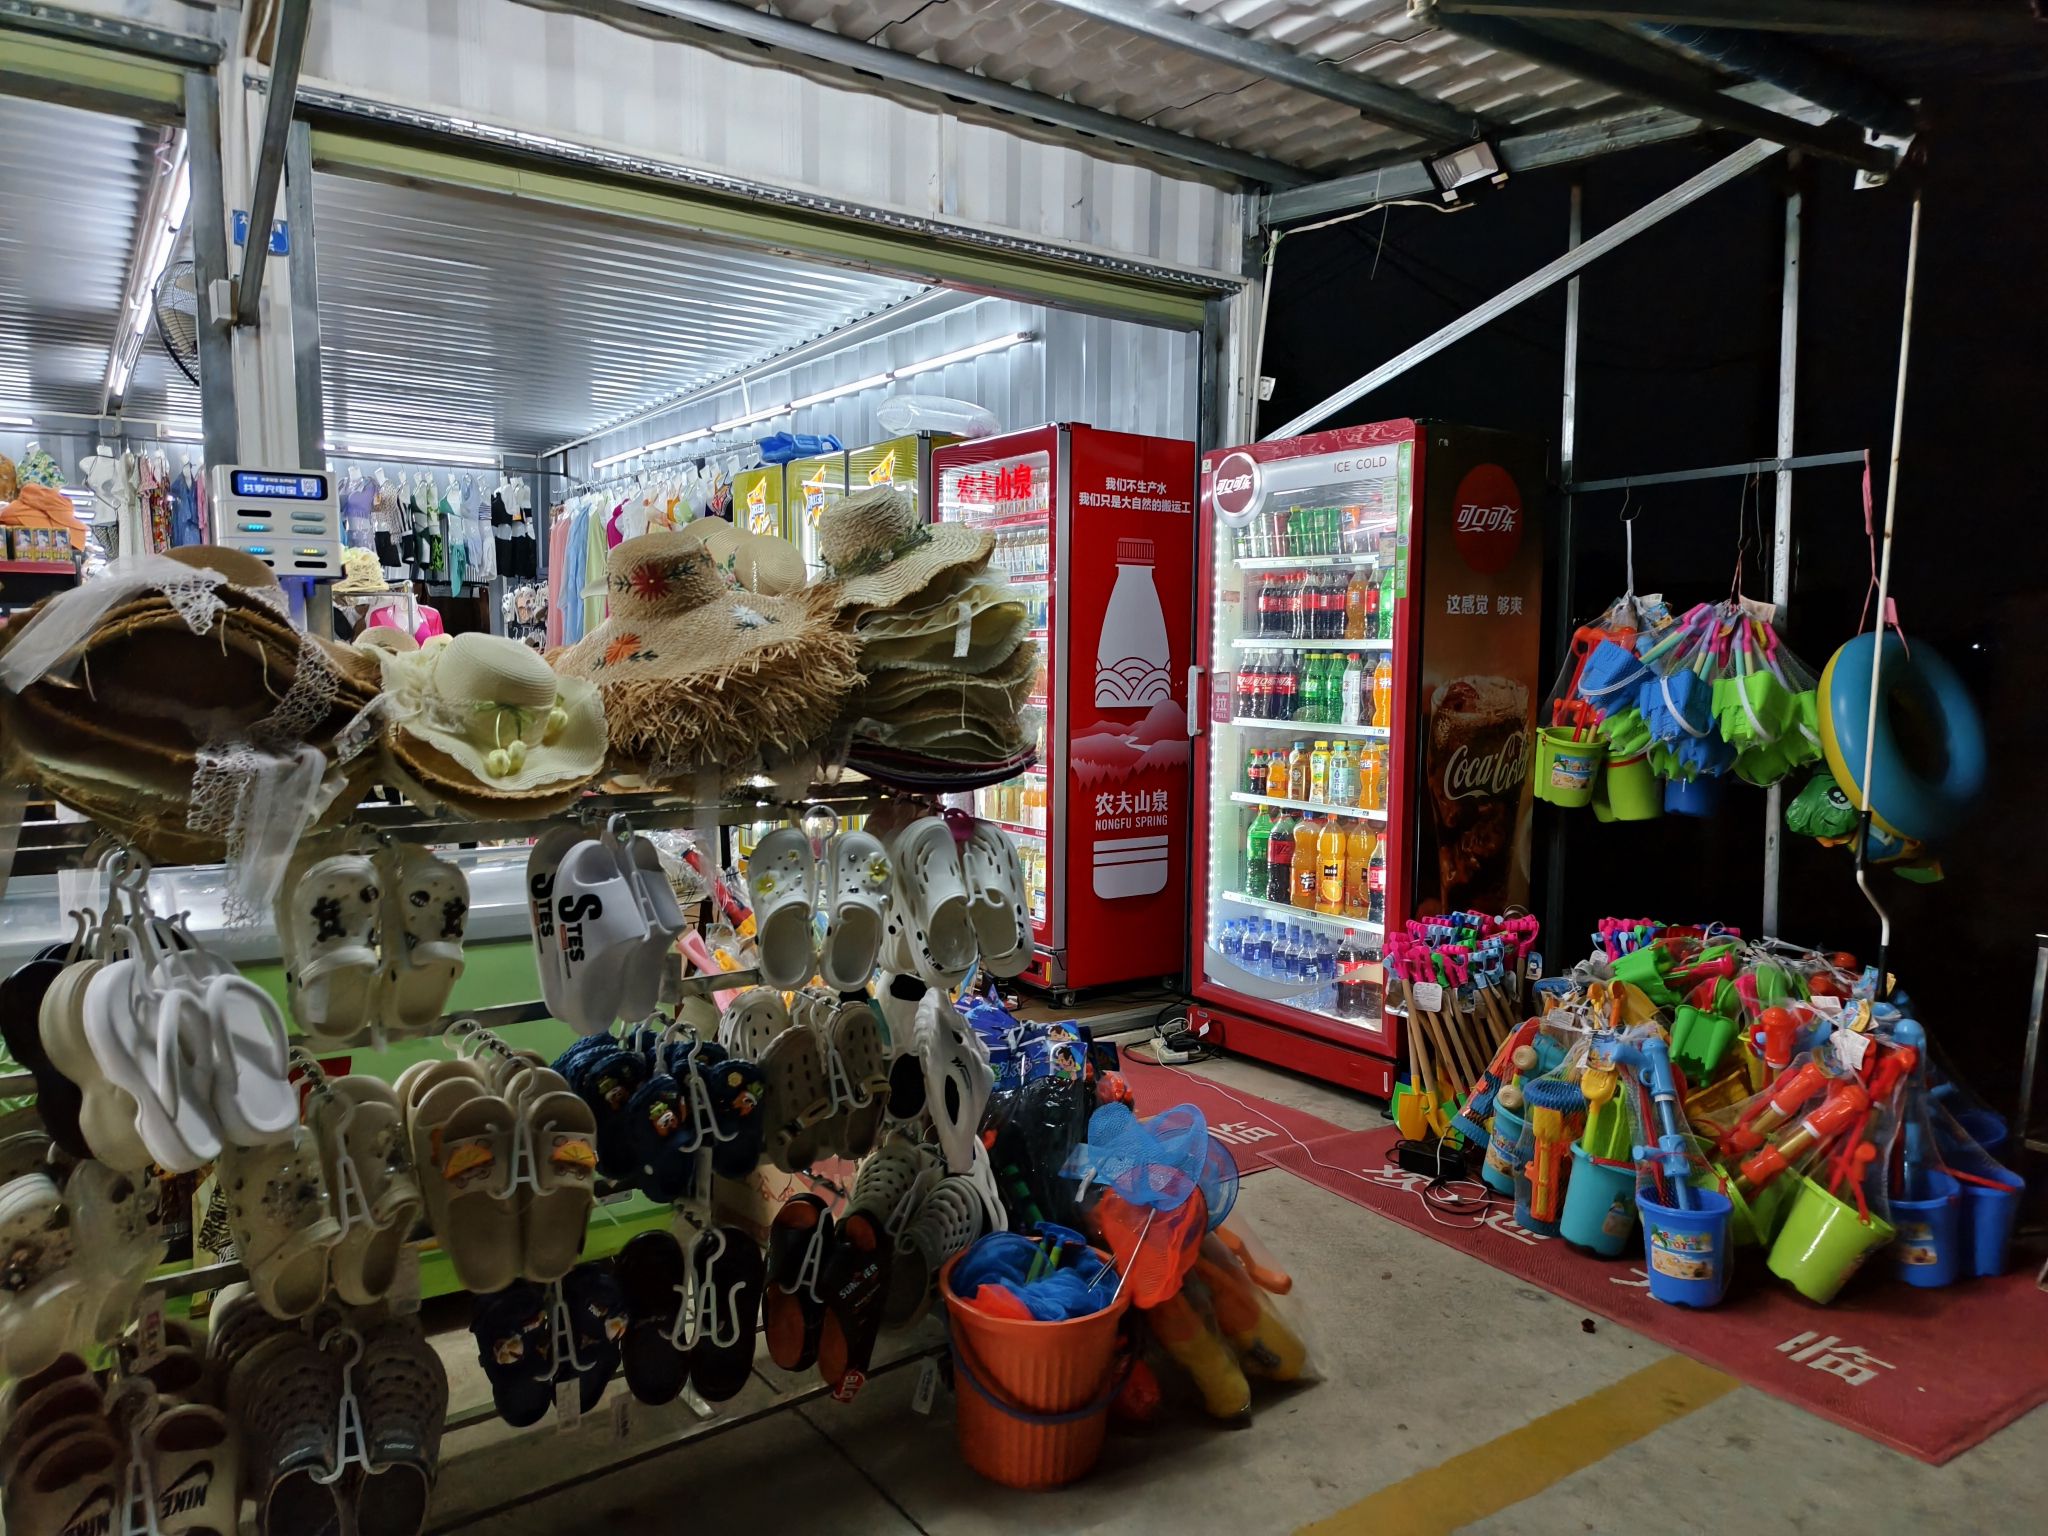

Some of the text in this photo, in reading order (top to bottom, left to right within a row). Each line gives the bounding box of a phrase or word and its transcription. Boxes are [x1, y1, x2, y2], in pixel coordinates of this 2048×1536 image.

[1333, 456, 1388, 473] ICE COLD
[1105, 477, 1167, 494] 我们不生产水
[1215, 473, 1254, 496] 可口可乐
[1078, 492, 1191, 513] 我们只是大自然的搬运工
[1456, 504, 1520, 533] 可口可乐
[1446, 594, 1523, 616] 这感觉 够爽
[1094, 788, 1169, 817] 农夫山泉
[1095, 814, 1168, 831] NONGFU SPRING
[558, 893, 603, 962] STES
